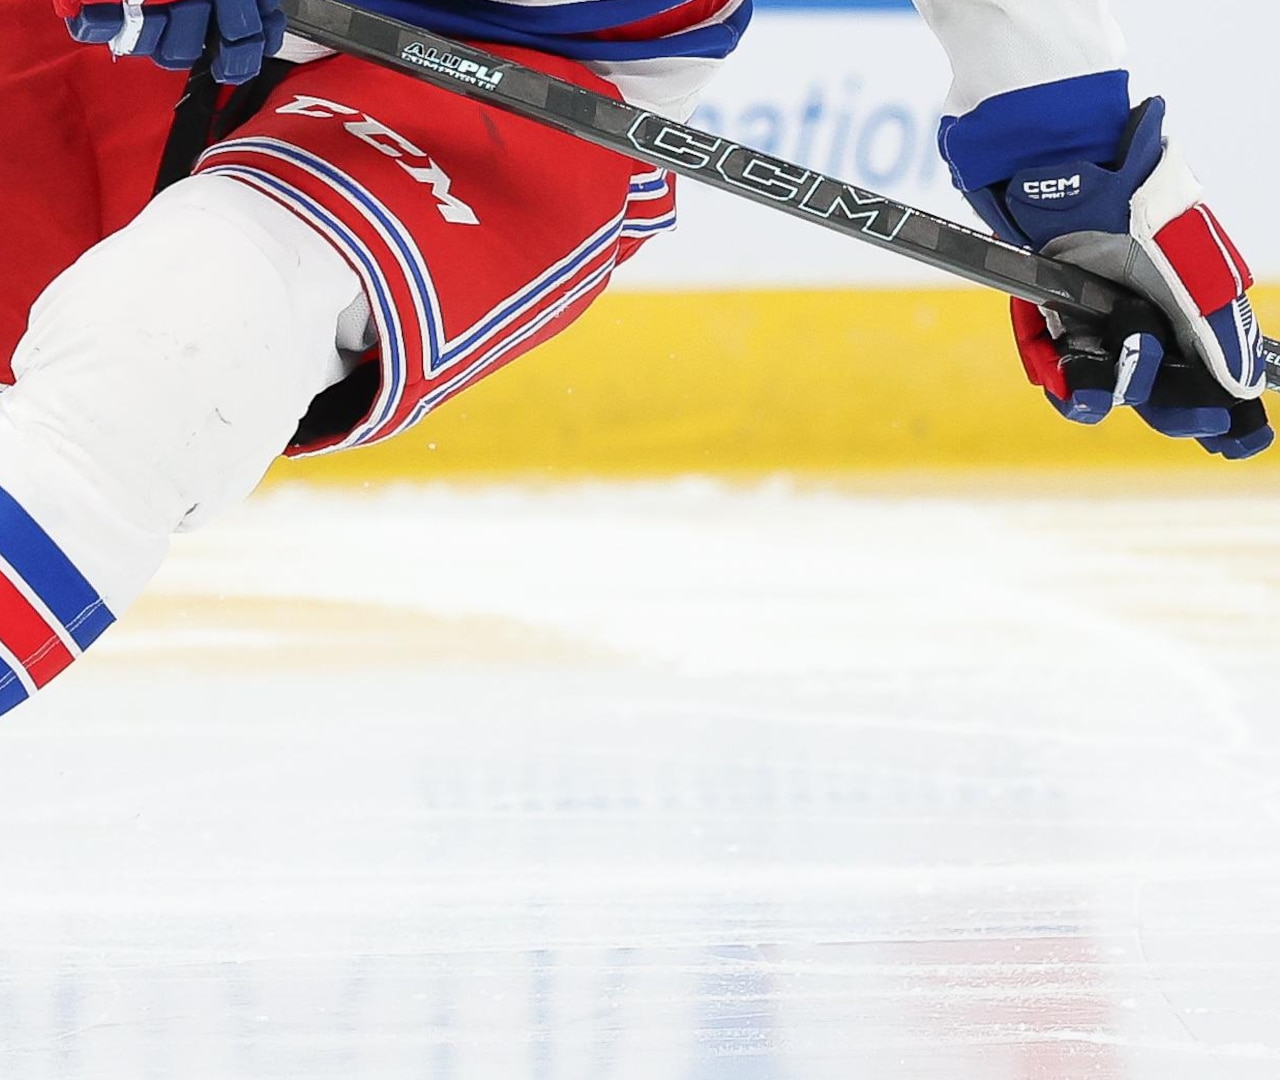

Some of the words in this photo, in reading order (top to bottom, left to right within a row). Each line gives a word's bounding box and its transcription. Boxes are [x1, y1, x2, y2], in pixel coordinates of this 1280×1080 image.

[275, 95, 481, 225] CCM
[627, 111, 914, 242] CCM
[1023, 174, 1081, 194] CCM
